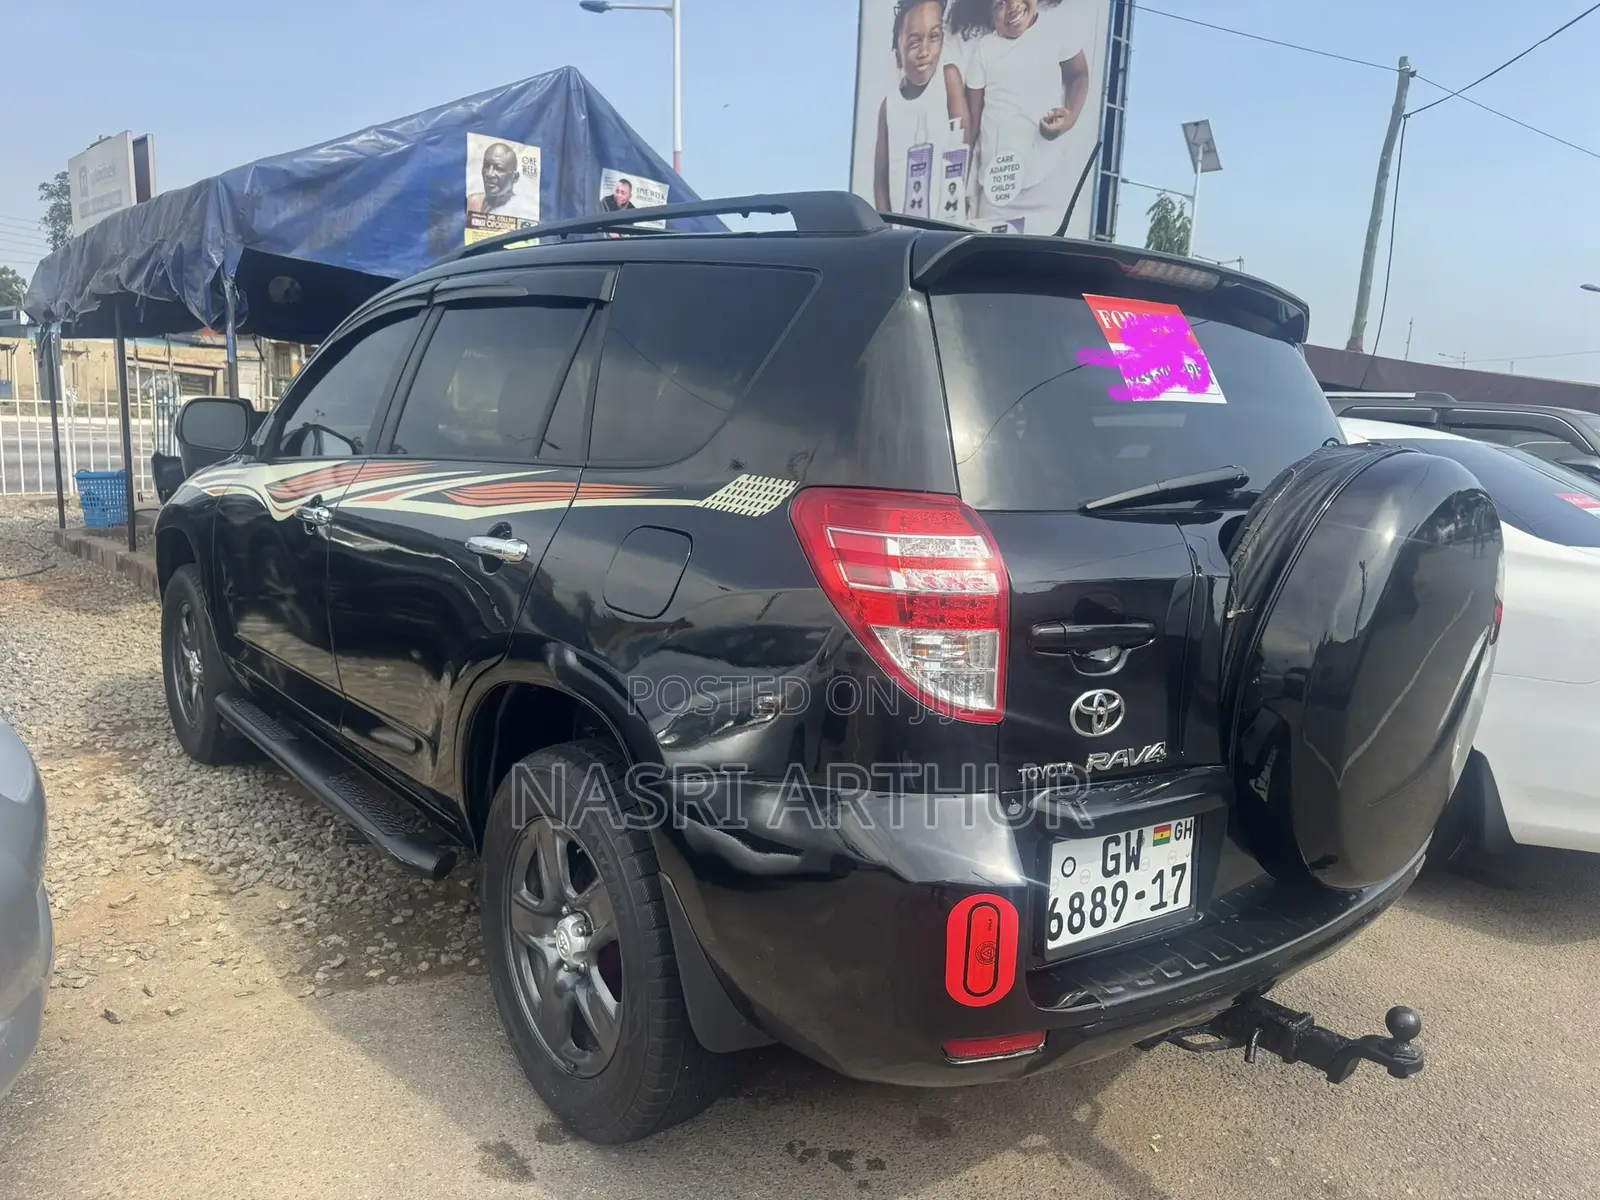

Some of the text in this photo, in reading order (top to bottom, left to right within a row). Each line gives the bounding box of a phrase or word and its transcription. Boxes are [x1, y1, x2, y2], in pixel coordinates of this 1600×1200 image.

[521, 156, 536, 166] ONE
[996, 155, 1014, 164] CARE
[522, 164, 537, 176] WEEK
[989, 163, 1020, 174] ADAPTED
[992, 173, 1016, 183] TO THE
[991, 183, 1015, 192] CHILD'S
[995, 193, 1010, 202] SKIN
[1017, 741, 1167, 784] TOYOTA RAV4
[1101, 819, 1193, 879] GW GH
[1047, 862, 1187, 941] 6889-17
